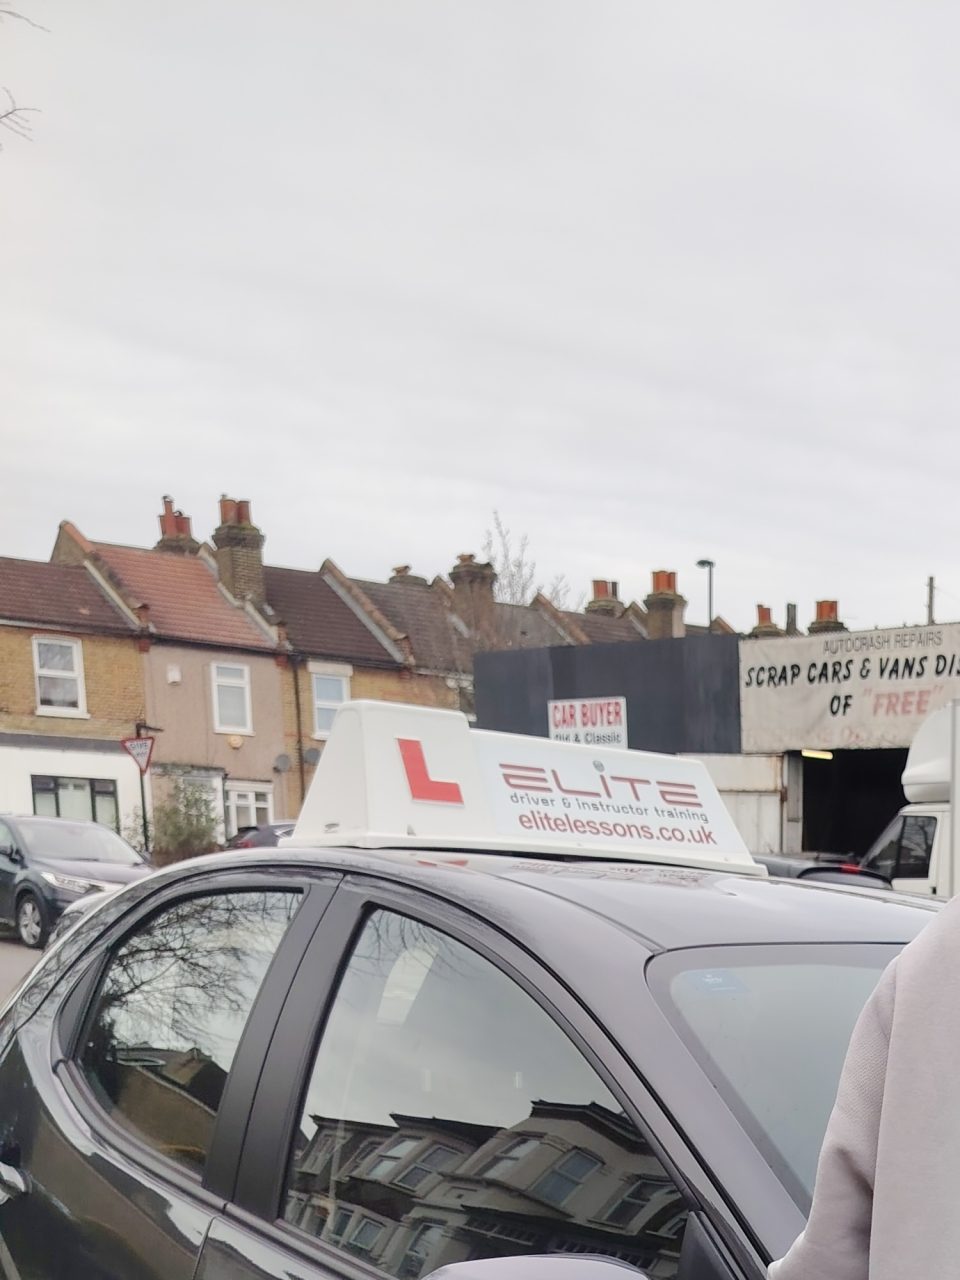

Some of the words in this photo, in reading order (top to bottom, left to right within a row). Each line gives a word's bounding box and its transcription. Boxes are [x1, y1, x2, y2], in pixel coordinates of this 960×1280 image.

[823, 634, 891, 655] AUTOCRASH
[895, 631, 943, 648] REPAIRS
[745, 664, 801, 688] SCRAP
[807, 659, 853, 684] CARS
[860, 658, 870, 679] &
[879, 656, 928, 680] VANS
[553, 703, 577, 729] CAR
[581, 701, 622, 728] BUYER
[829, 695, 852, 716] OF
[584, 731, 621, 745] Classic
[397, 738, 464, 804] L
[499, 763, 703, 808] ELITE
[510, 792, 556, 809] driver
[562, 797, 571, 808] &
[577, 798, 649, 817] instructor
[655, 804, 709, 824] training
[518, 810, 717, 845] elitelessons.co.uk
